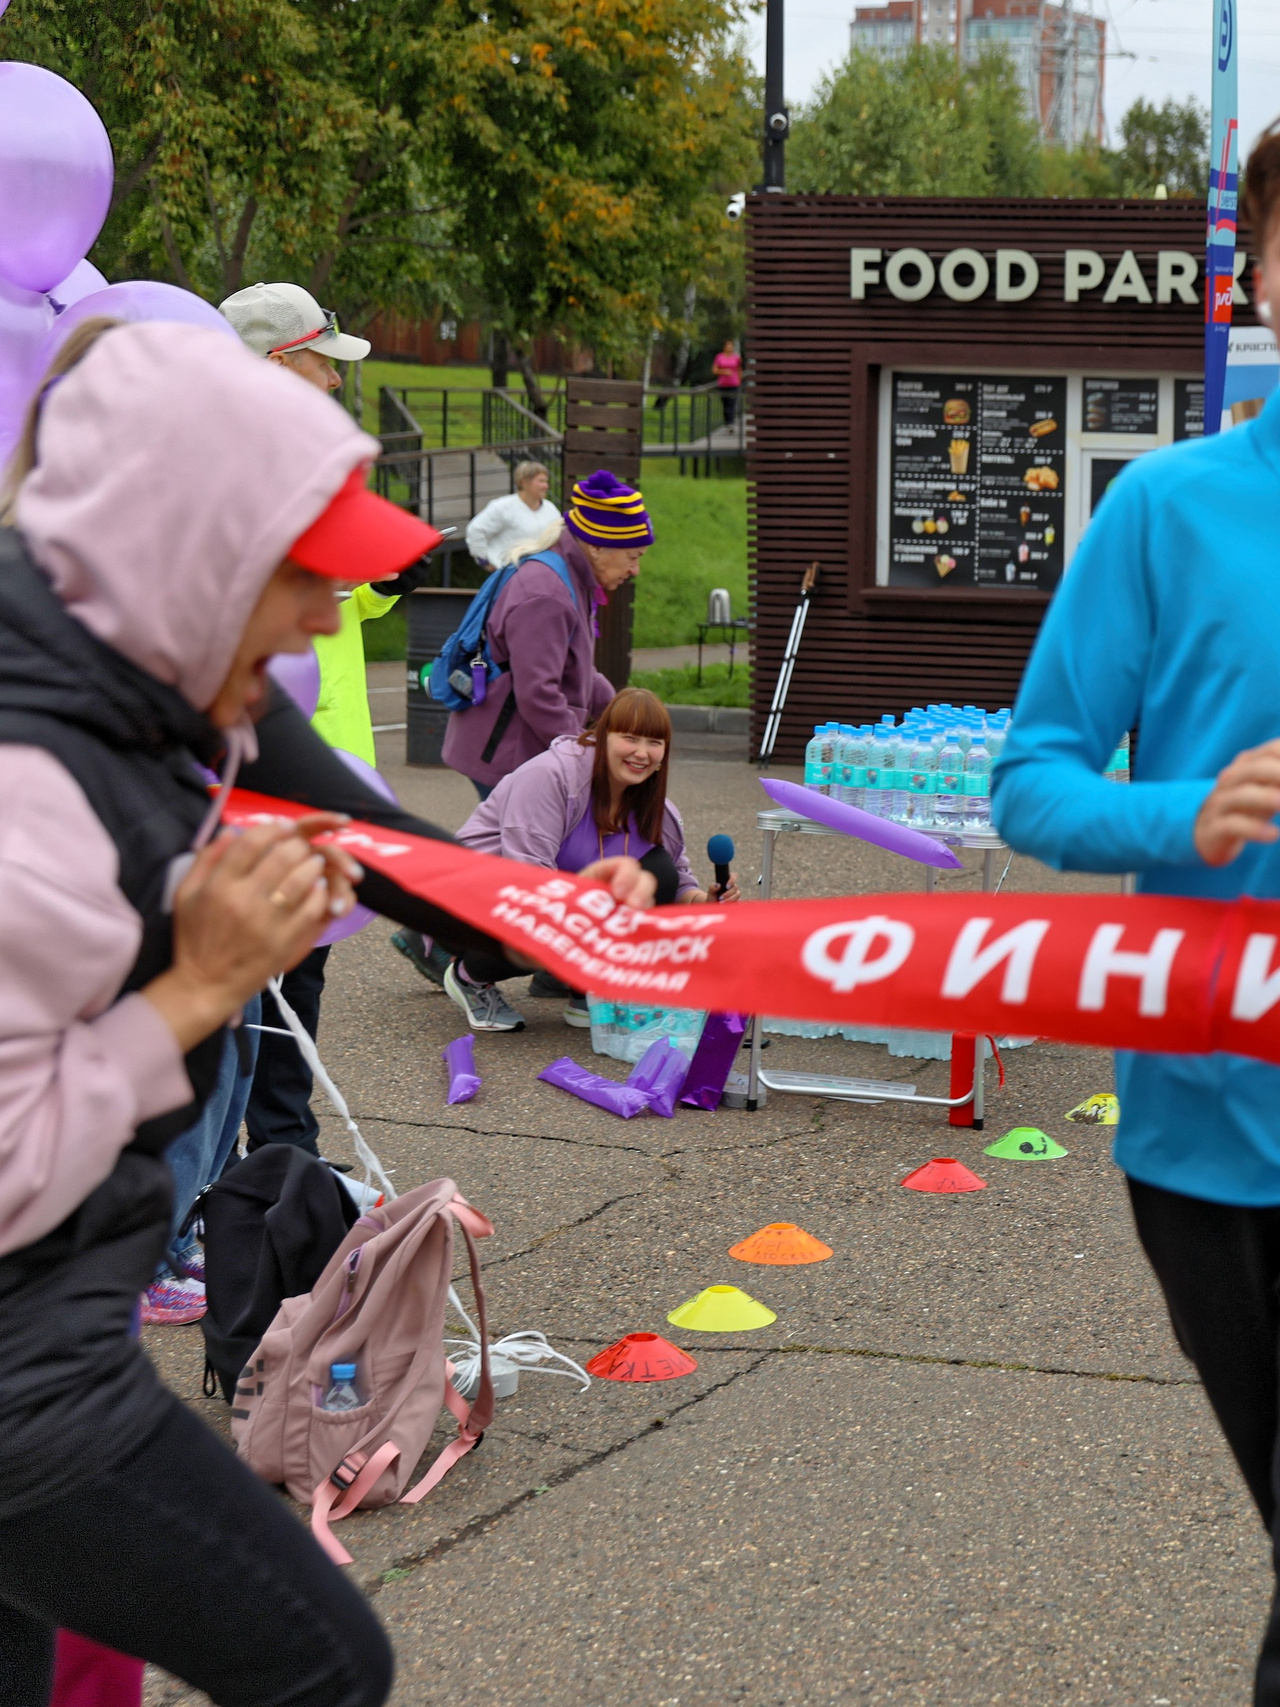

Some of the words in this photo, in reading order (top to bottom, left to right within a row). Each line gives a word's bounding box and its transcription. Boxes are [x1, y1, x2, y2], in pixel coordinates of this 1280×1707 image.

[850, 247, 1039, 302] FOOD
[536, 878, 577, 899] 5
[490, 902, 692, 992] НАБЕРЕЖНАЯ
[497, 885, 715, 965] КРАСНОЯРСК
